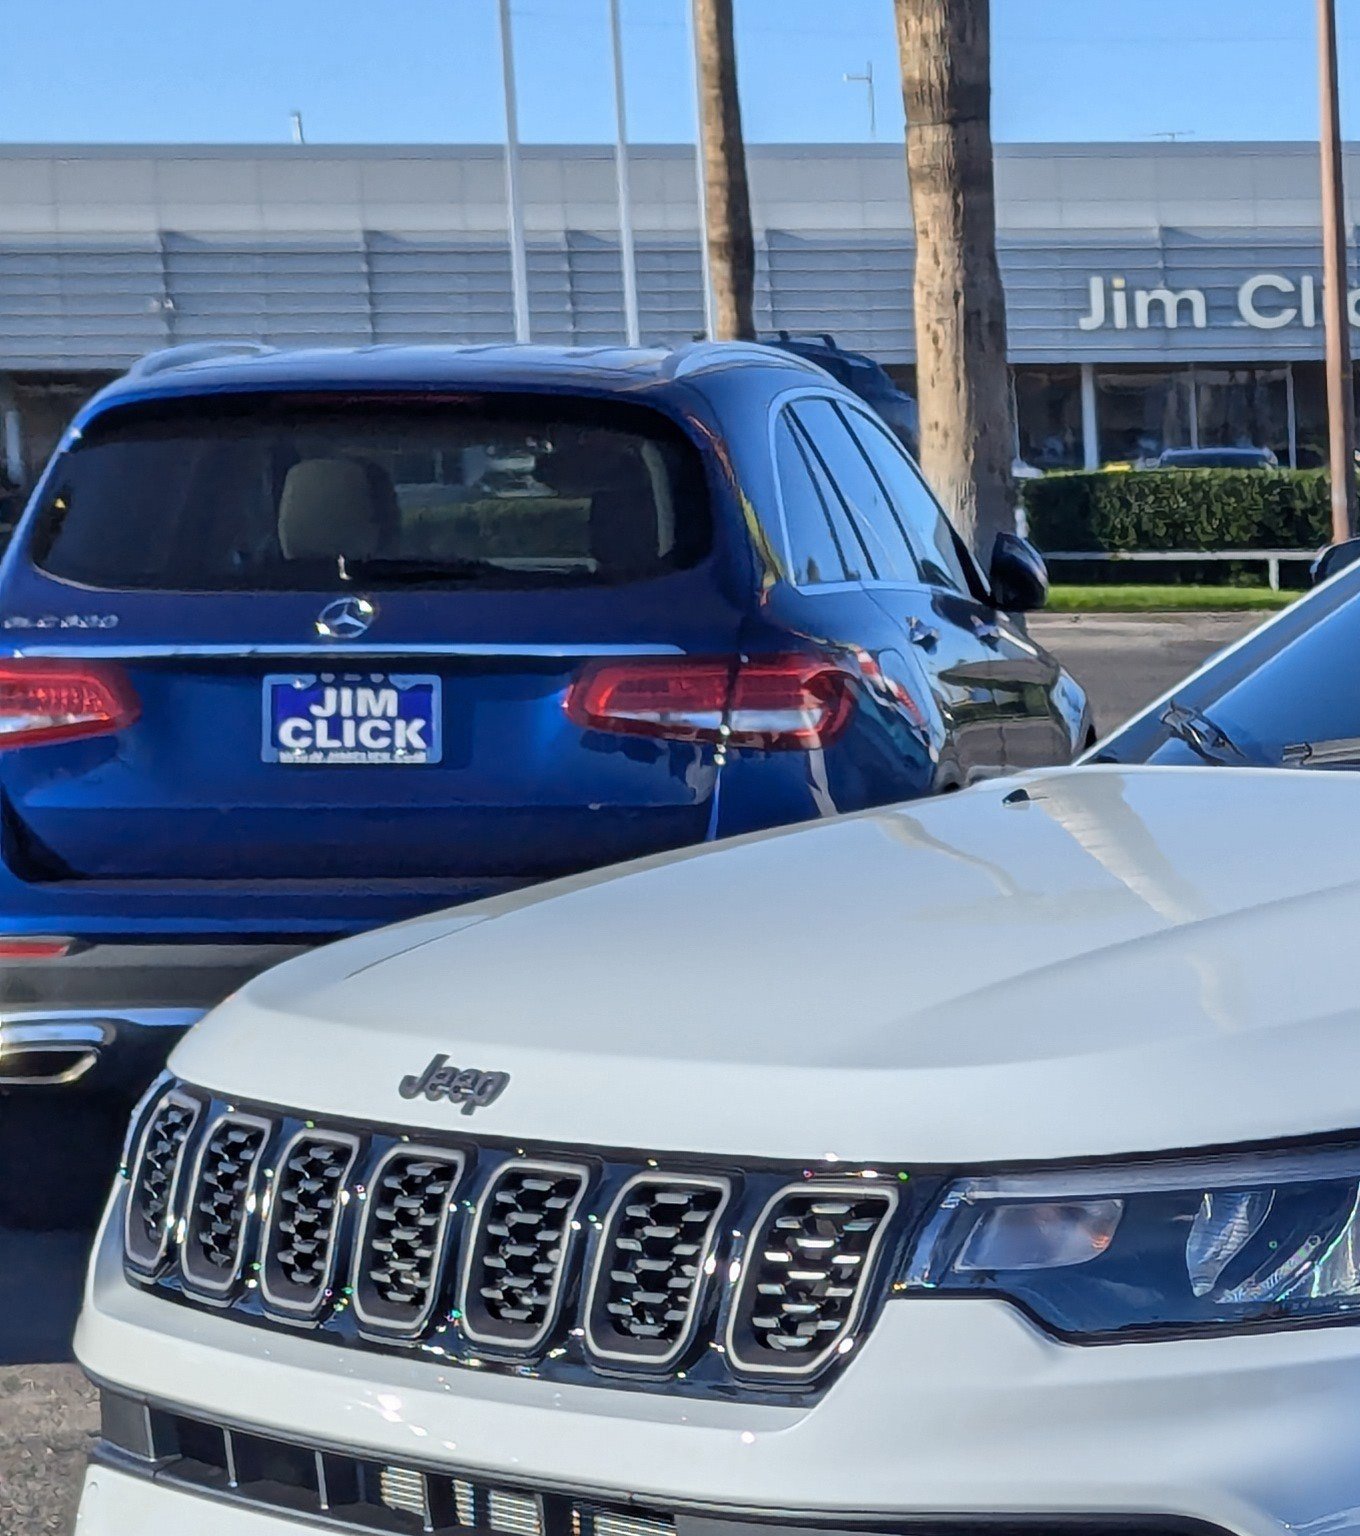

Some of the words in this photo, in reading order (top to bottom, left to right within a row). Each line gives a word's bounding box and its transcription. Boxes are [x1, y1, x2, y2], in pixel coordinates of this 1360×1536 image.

[1079, 276, 1207, 330] Jim
[309, 687, 398, 717] JIM
[278, 717, 427, 749] CLICK
[398, 1053, 511, 1116] Jeep
